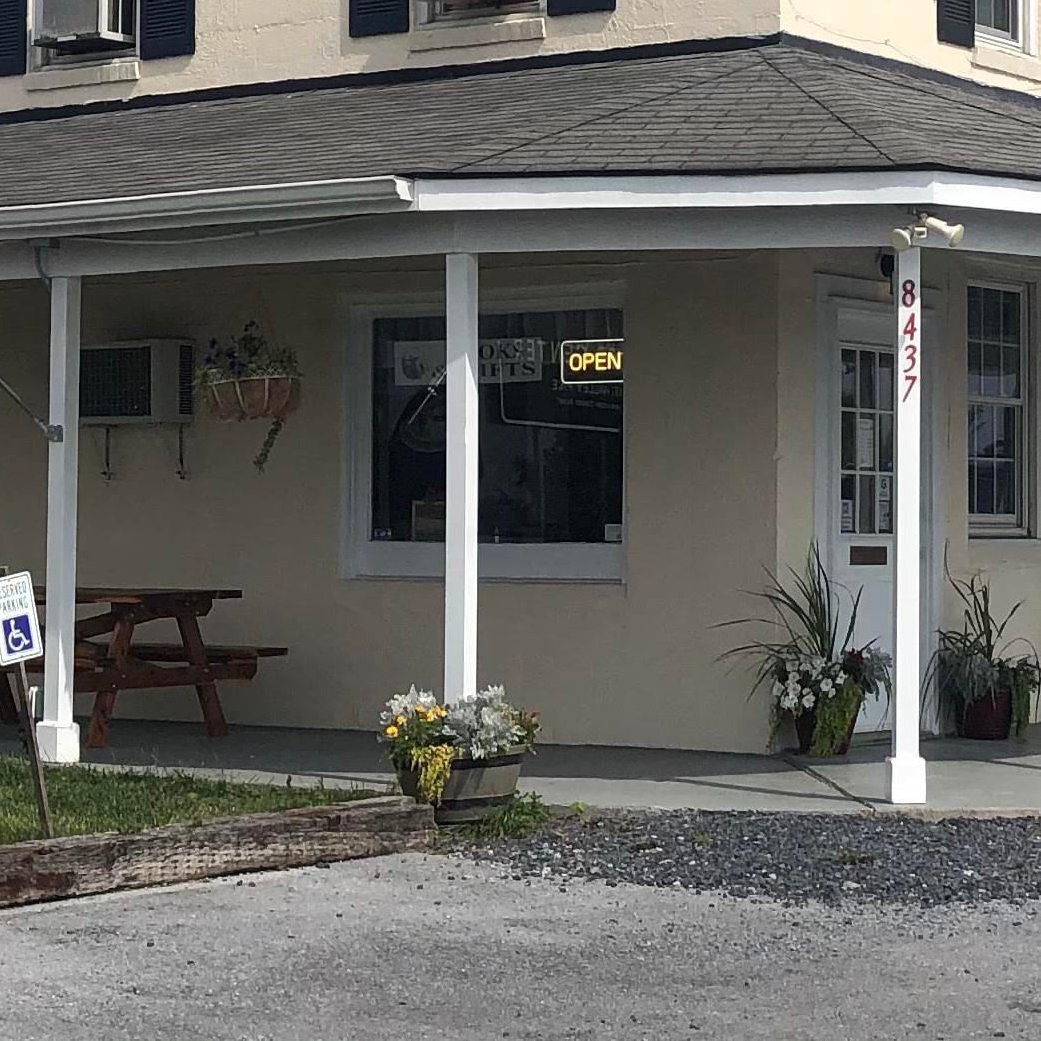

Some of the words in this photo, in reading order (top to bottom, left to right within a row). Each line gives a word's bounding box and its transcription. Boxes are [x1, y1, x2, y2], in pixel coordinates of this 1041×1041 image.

[901, 279, 918, 403] 8437
[481, 361, 535, 377] IFTS
[569, 351, 622, 372] OPEN
